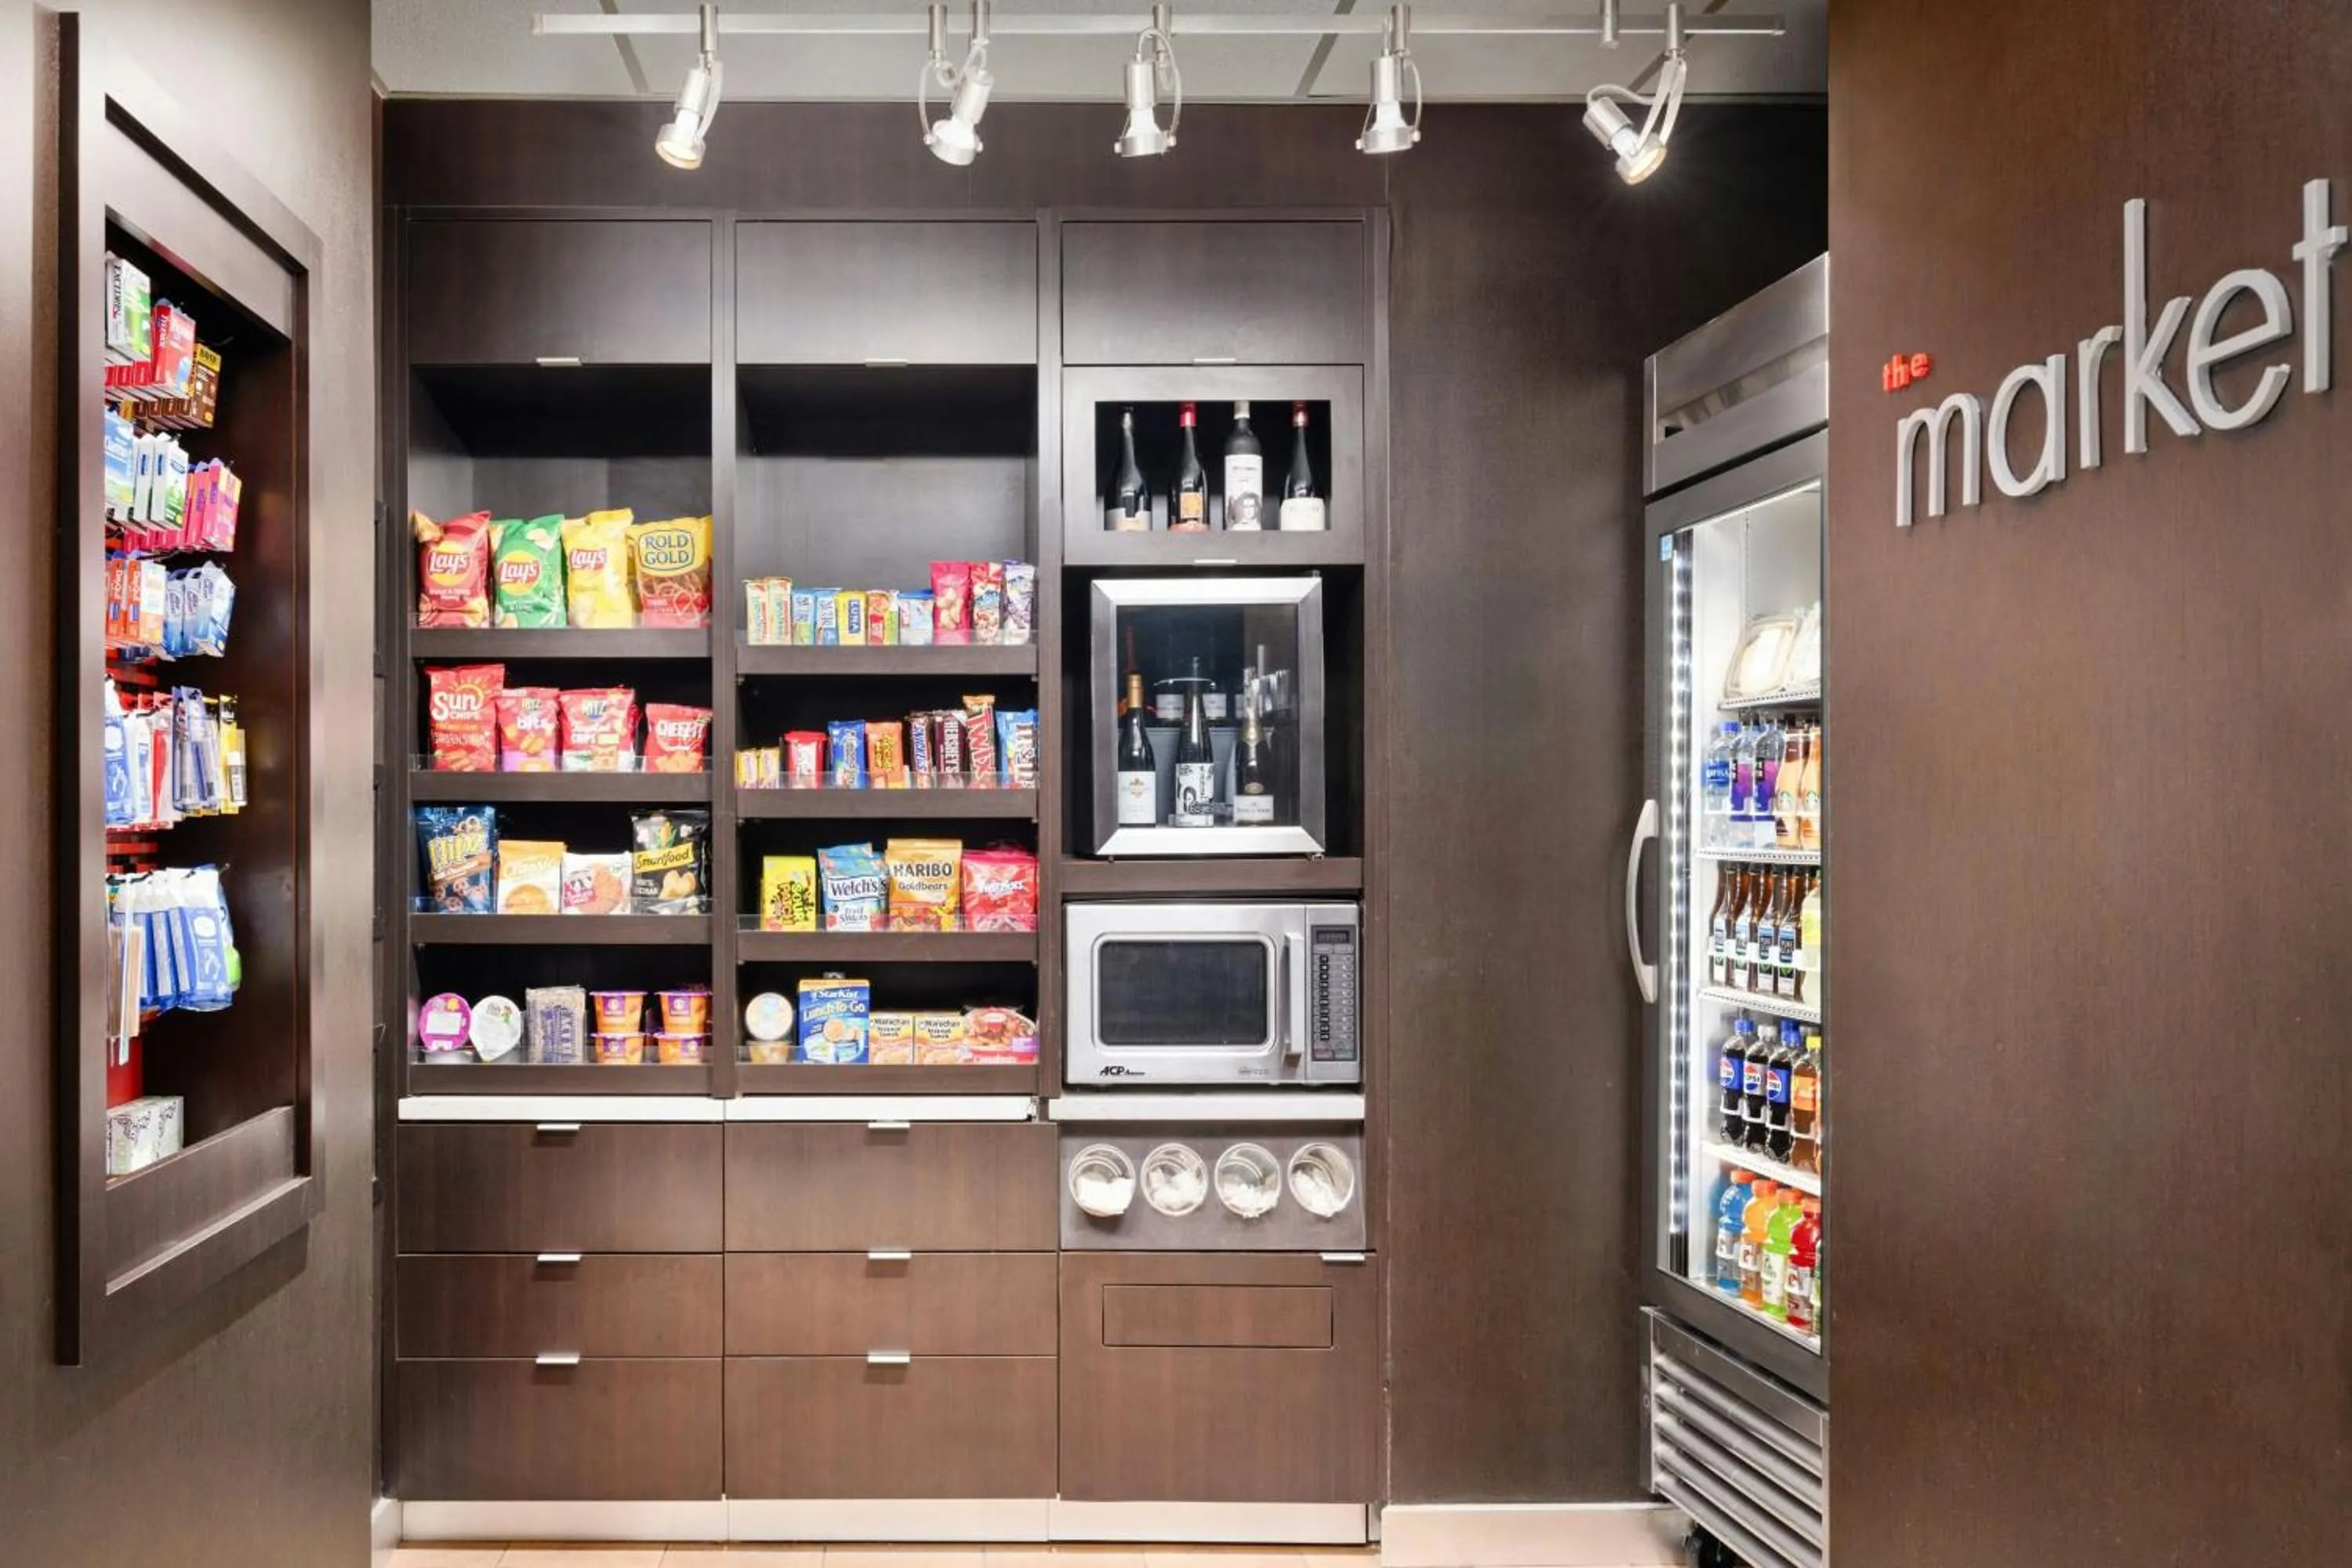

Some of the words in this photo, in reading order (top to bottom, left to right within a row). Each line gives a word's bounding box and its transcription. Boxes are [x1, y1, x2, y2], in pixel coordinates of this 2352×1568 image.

[1896, 179, 2349, 527] market
[1882, 352, 1931, 391] the
[644, 535, 688, 549] ROLD
[429, 550, 469, 574] Lay's
[570, 549, 607, 569] Lay's
[644, 551, 689, 565] GOLD
[499, 560, 539, 584] Lay's
[849, 601, 860, 632] LUNA
[432, 691, 483, 721] Sun
[967, 712, 994, 779] TWIX
[635, 846, 691, 869] Smartfood
[893, 863, 953, 877] HARIBO
[830, 877, 879, 897] Welch's
[898, 880, 949, 891] Goldbears
[818, 989, 860, 999] StarKist
[1099, 1065, 1125, 1076] ACP
